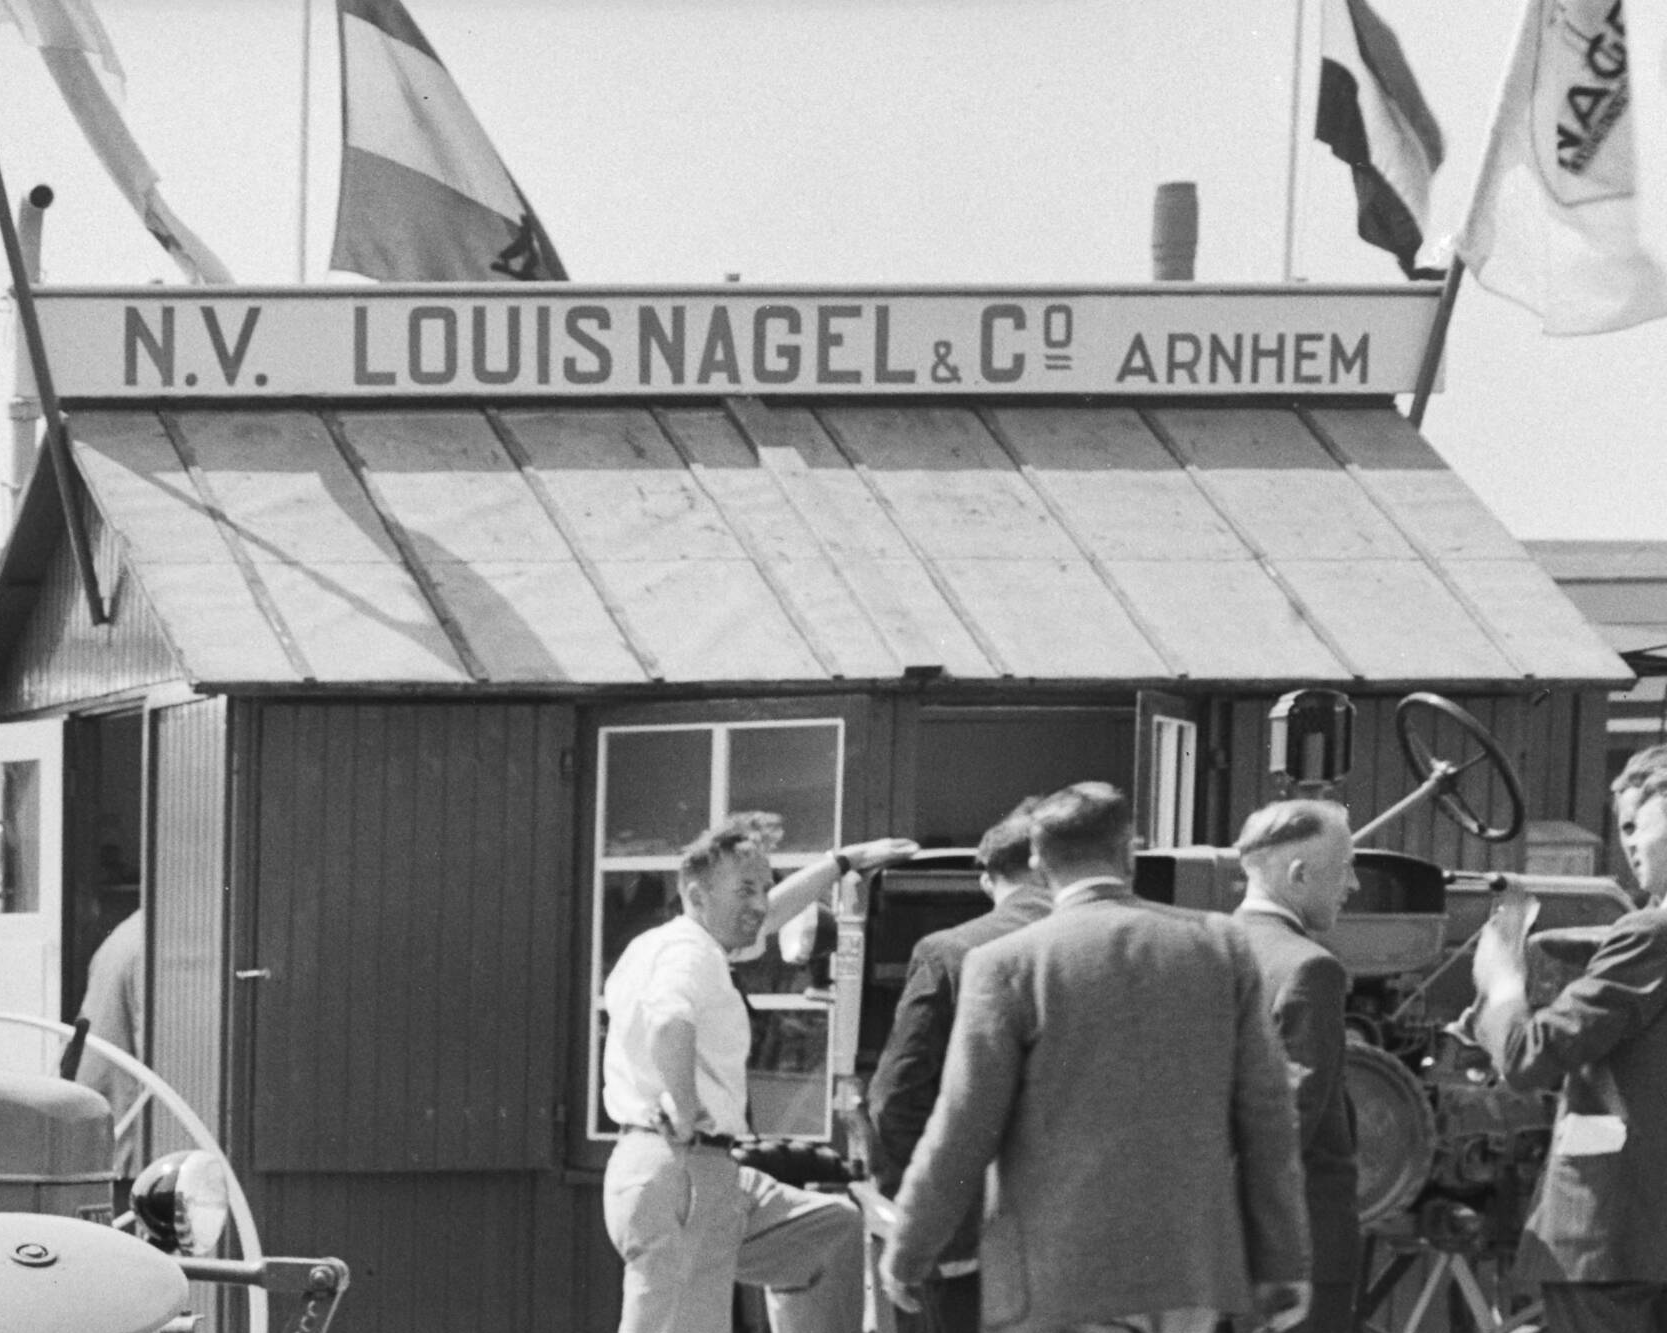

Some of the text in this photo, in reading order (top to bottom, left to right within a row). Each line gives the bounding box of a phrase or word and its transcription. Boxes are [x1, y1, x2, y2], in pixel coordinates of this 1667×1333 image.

[123, 306, 269, 388] N.V.
[354, 305, 613, 386] LOUIS
[639, 304, 917, 386] NAGEL
[930, 339, 962, 384] &
[1116, 332, 1371, 385] ARNHEM
